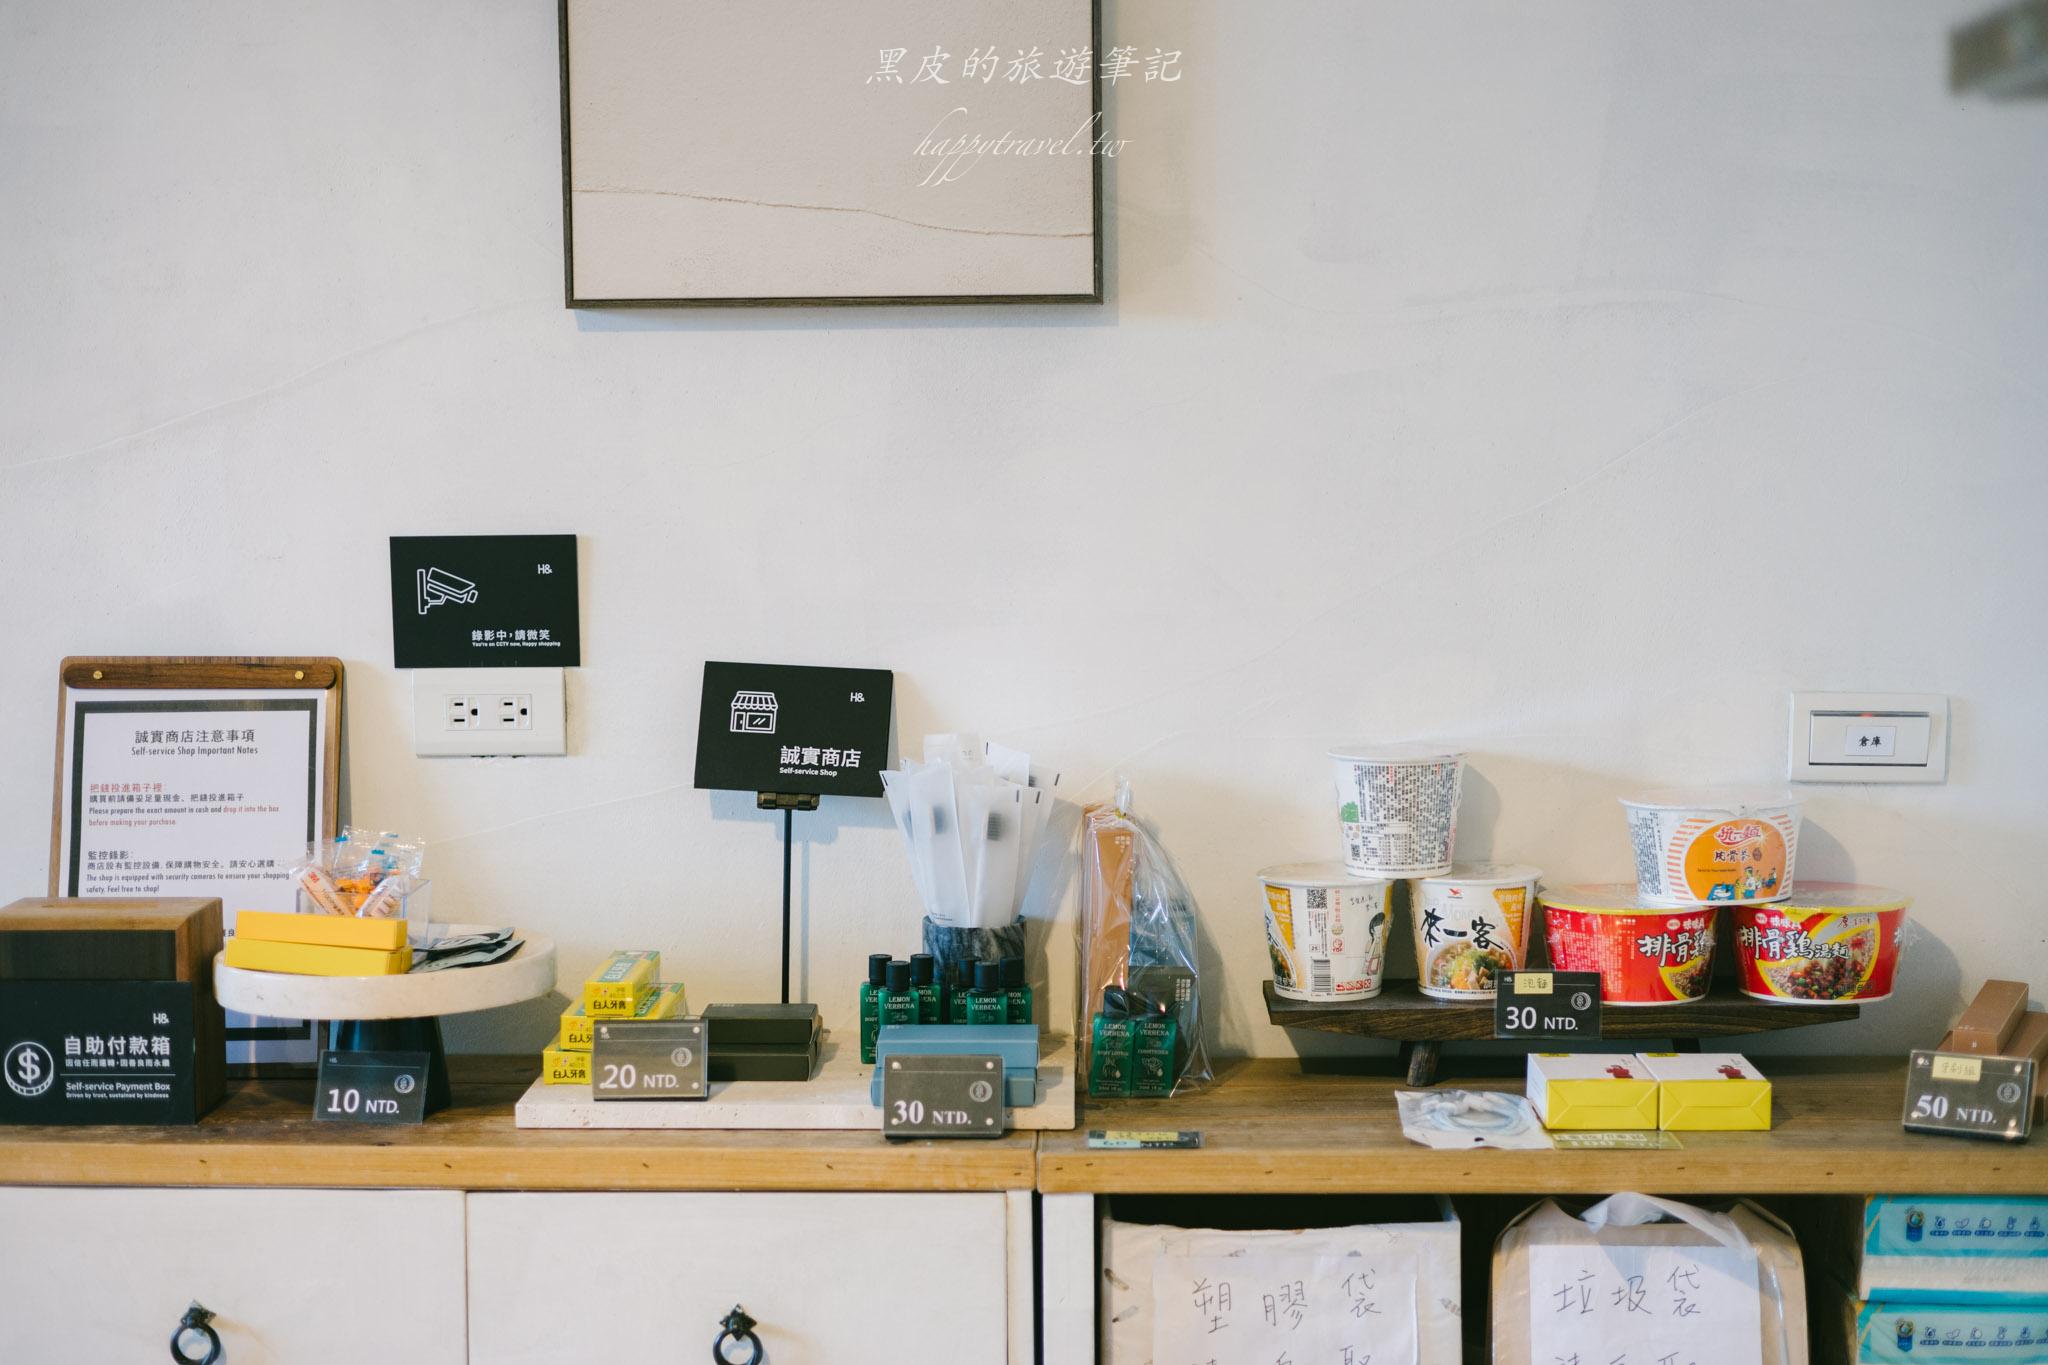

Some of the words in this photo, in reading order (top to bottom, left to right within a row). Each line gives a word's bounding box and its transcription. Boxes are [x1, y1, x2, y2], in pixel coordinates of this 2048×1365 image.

[537, 564, 552, 574] H&
[472, 629, 550, 641] 錄影中，請微笑
[850, 692, 865, 702] H&
[135, 729, 255, 743] 誠實商店注意事項
[1858, 735, 1882, 748] 倉庫
[132, 746, 175, 756] Self-service
[177, 746, 196, 756] Shop
[197, 746, 235, 756] Important
[237, 746, 258, 754] Notes
[780, 745, 861, 768] 誠實商店
[779, 767, 818, 775] Self-service
[819, 769, 837, 777] Shop
[195, 805, 209, 813] cash
[210, 805, 222, 813] and
[110, 819, 132, 827] making
[99, 874, 113, 882] shop
[121, 873, 149, 882] equipped
[151, 873, 164, 881] with
[165, 873, 189, 881] security
[190, 872, 216, 880] cameras
[247, 873, 261, 881] your
[262, 872, 290, 881] shopping
[107, 885, 120, 893] Feel
[121, 885, 134, 893] free
[143, 884, 160, 894] shop!
[593, 1000, 626, 1010] 白人牙膏
[153, 1013, 170, 1024] H&
[1505, 1006, 1537, 1030] 30
[1544, 1017, 1579, 1030] NTD.
[569, 1034, 592, 1043] 白人牙
[65, 1035, 171, 1056] 自助付款箱
[553, 1070, 586, 1079] 白人牙膏
[602, 1064, 636, 1089] 20
[643, 1074, 679, 1089] NTD.
[66, 1082, 115, 1091] Self-service
[116, 1082, 153, 1092] Payment
[155, 1082, 171, 1091] Box
[327, 1088, 360, 1113] 10
[365, 1099, 400, 1114] NTD.
[894, 1099, 924, 1124] 30
[932, 1109, 972, 1125] NTD.
[1917, 1094, 1948, 1118] 50
[1956, 1107, 1997, 1124] NTD.
[1553, 1264, 1703, 1317] 垃圾袋
[1192, 1268, 1382, 1333] 塑膠袋
